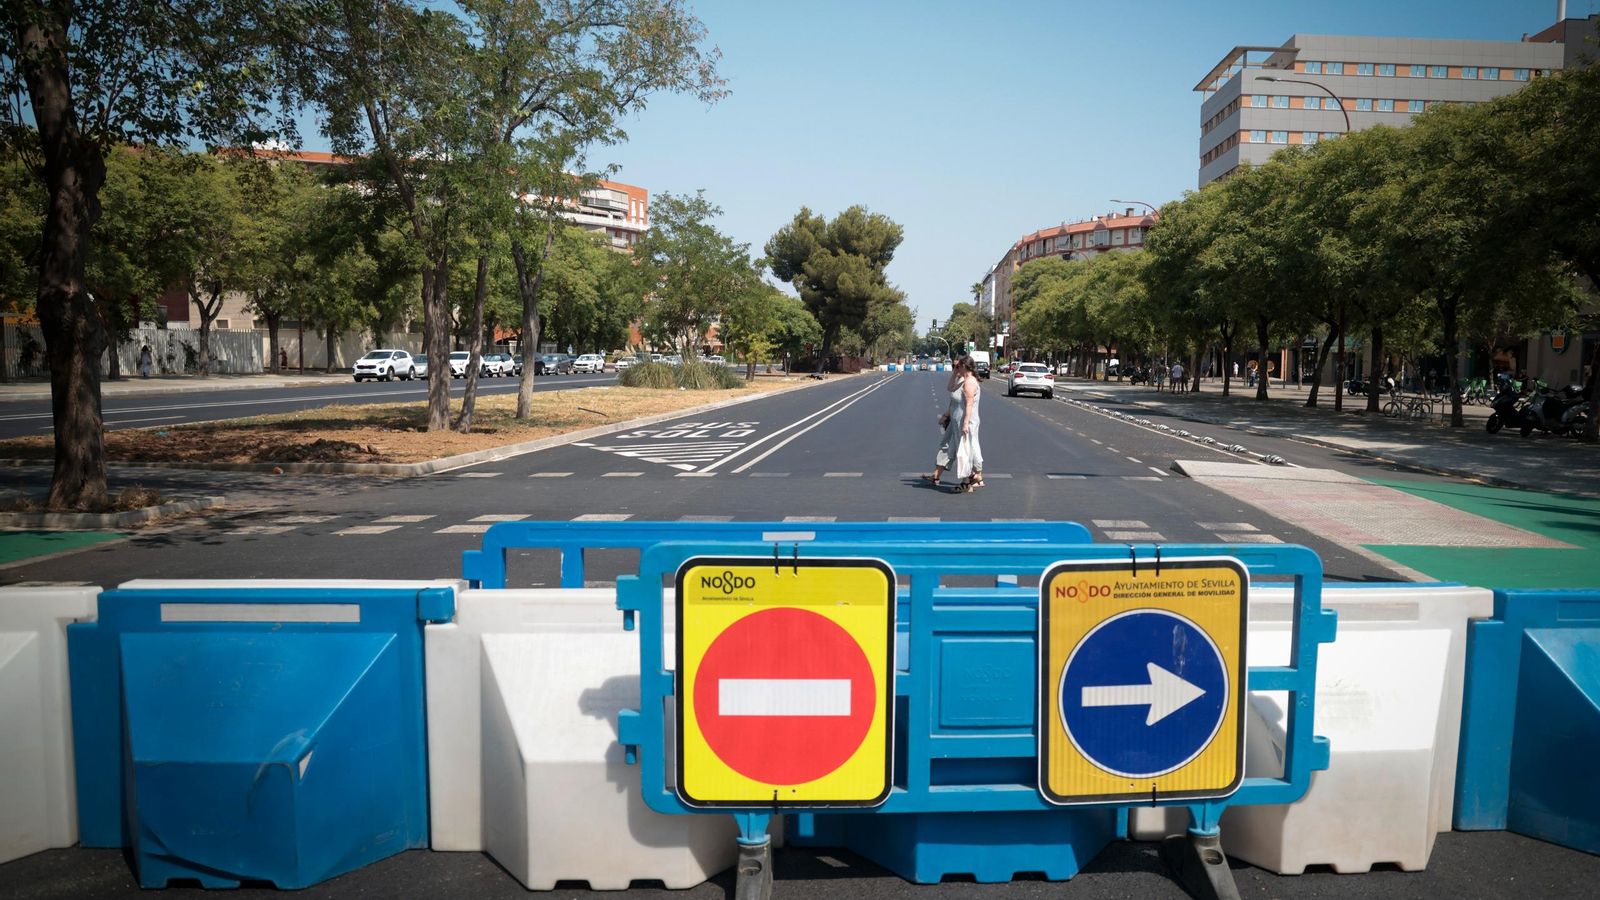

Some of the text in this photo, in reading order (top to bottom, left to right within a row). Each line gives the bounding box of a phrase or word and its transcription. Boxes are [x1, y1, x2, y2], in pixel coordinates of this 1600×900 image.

[665, 421, 760, 429] BUS
[616, 429, 757, 439] SOLO
[1113, 591, 1152, 599] DIRECCIÓN
[1153, 590, 1185, 598] GENERAL
[1198, 589, 1236, 597] MOVILIDAD
